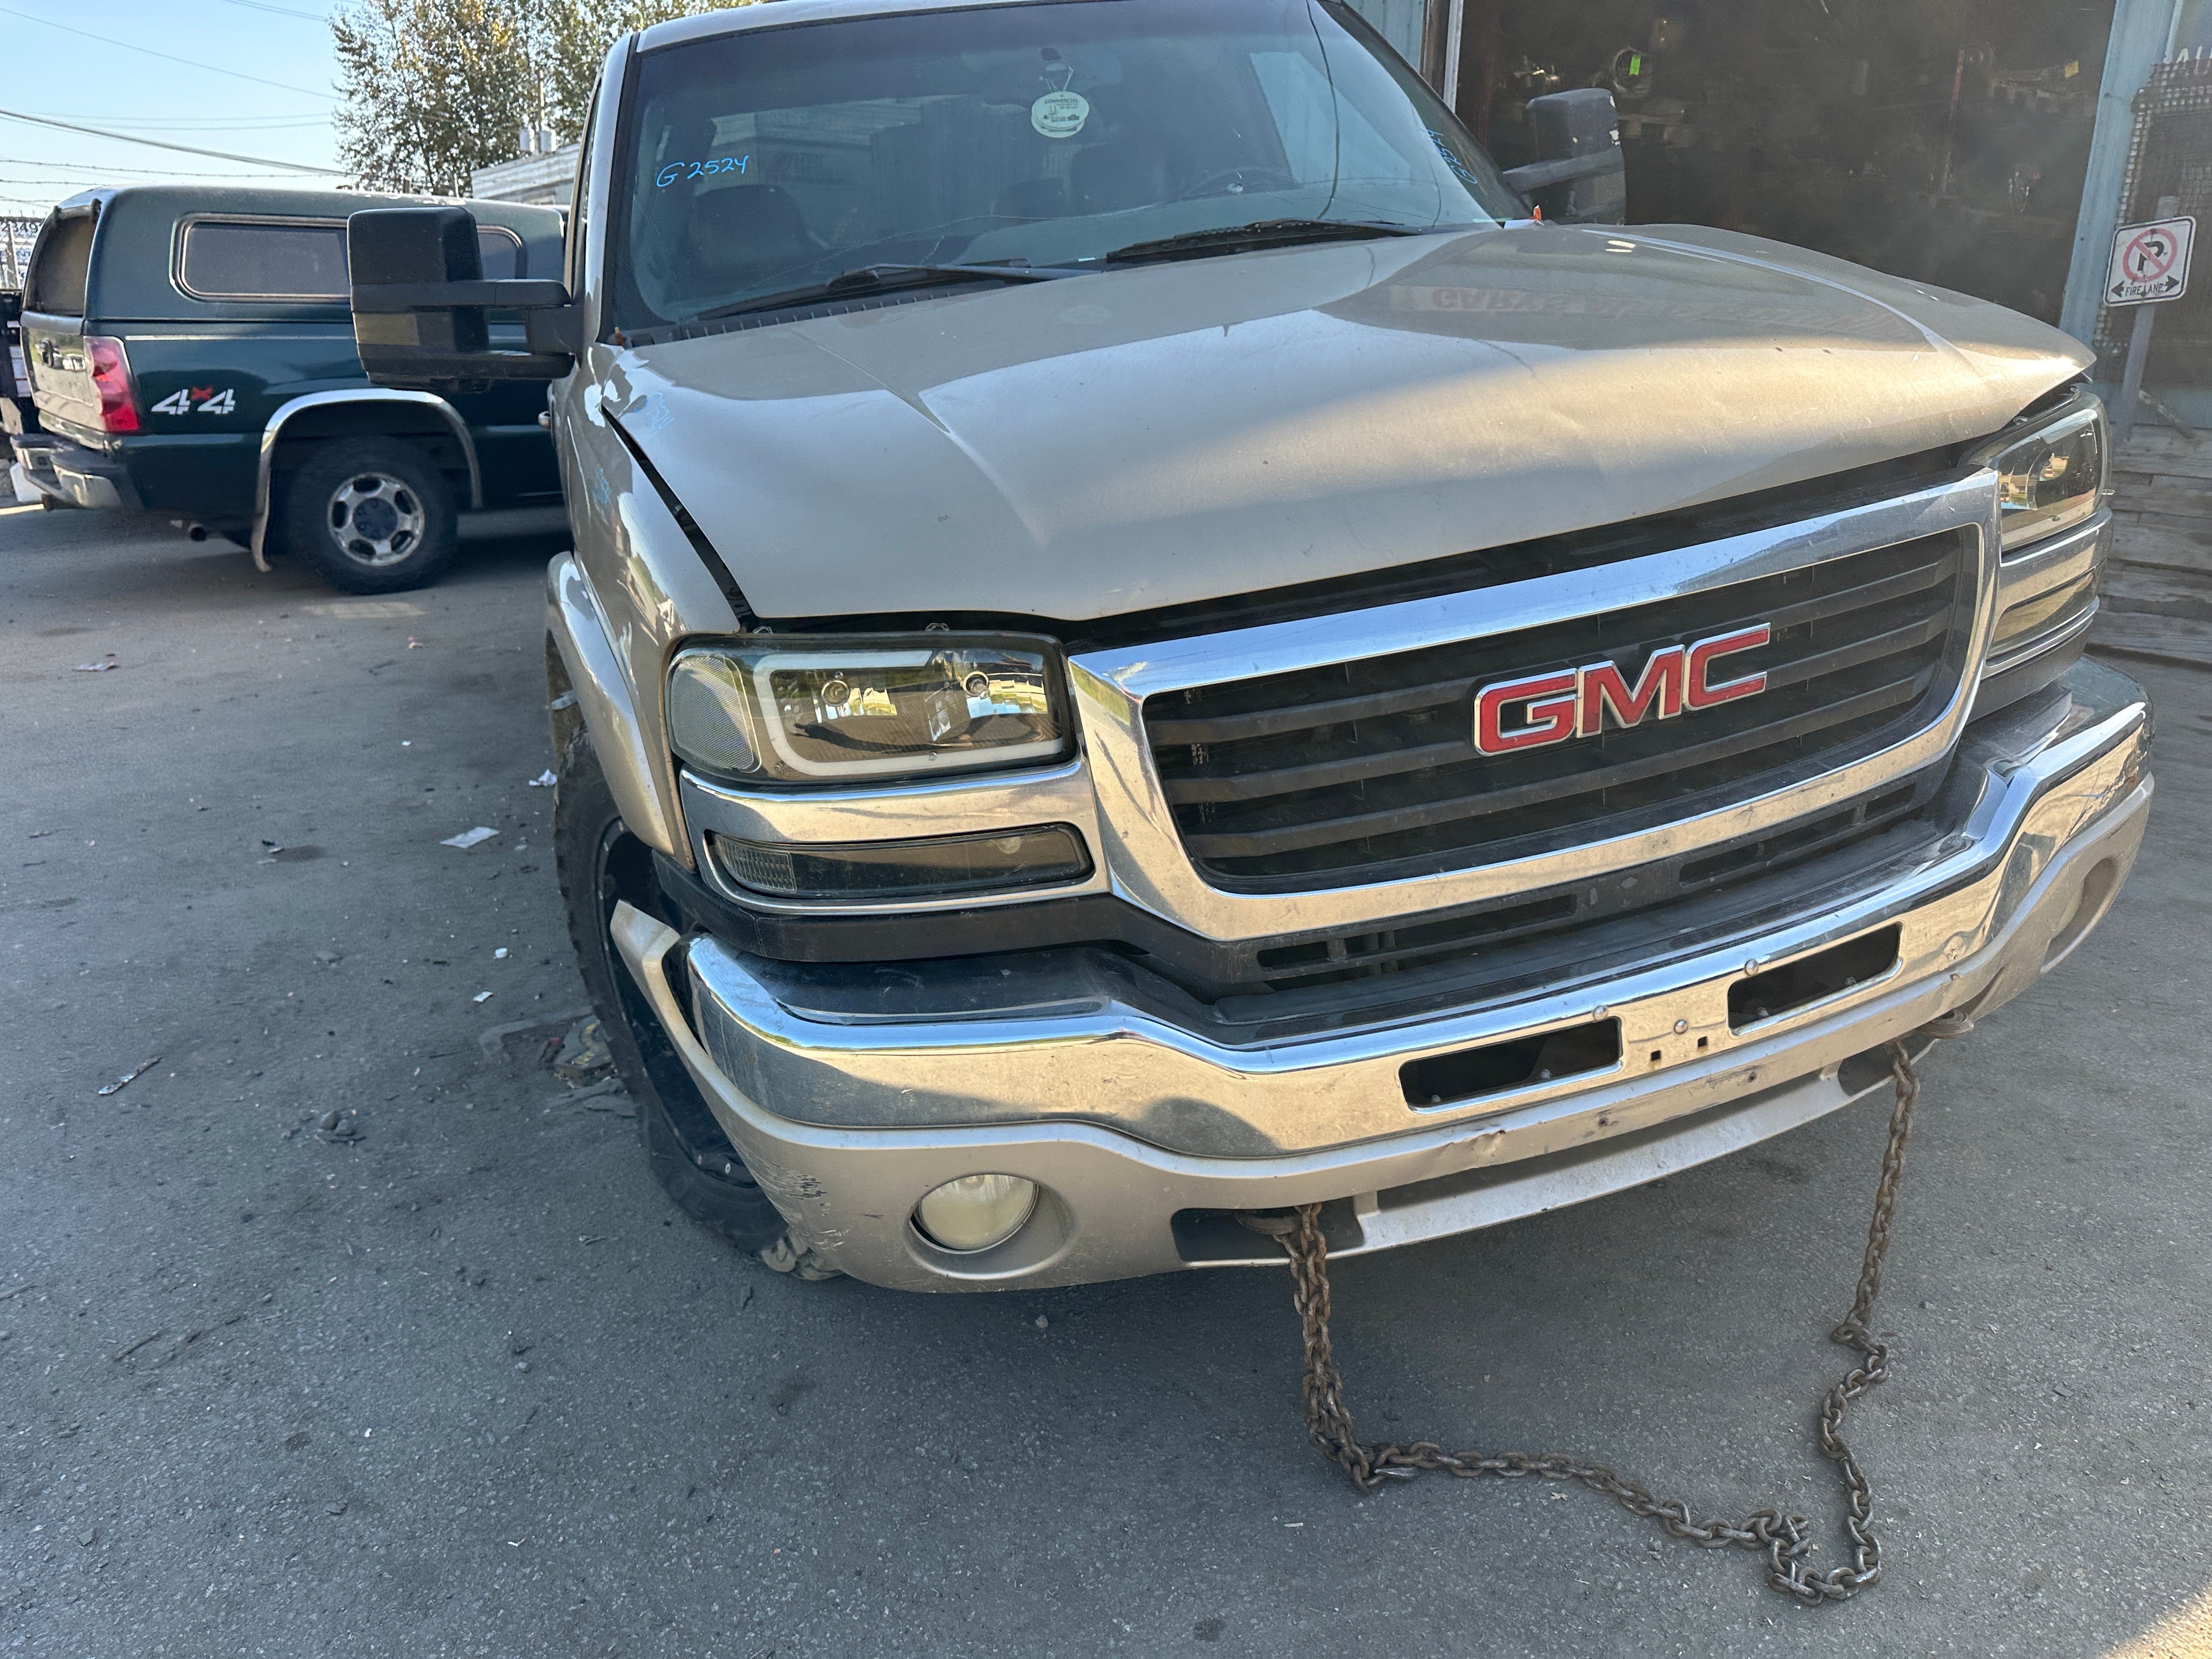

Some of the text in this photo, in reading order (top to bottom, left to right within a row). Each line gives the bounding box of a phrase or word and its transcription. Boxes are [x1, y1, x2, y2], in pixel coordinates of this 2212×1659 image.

[2124, 283, 2164, 297] FIRE LANE
[1474, 622, 1771, 756] GMC
